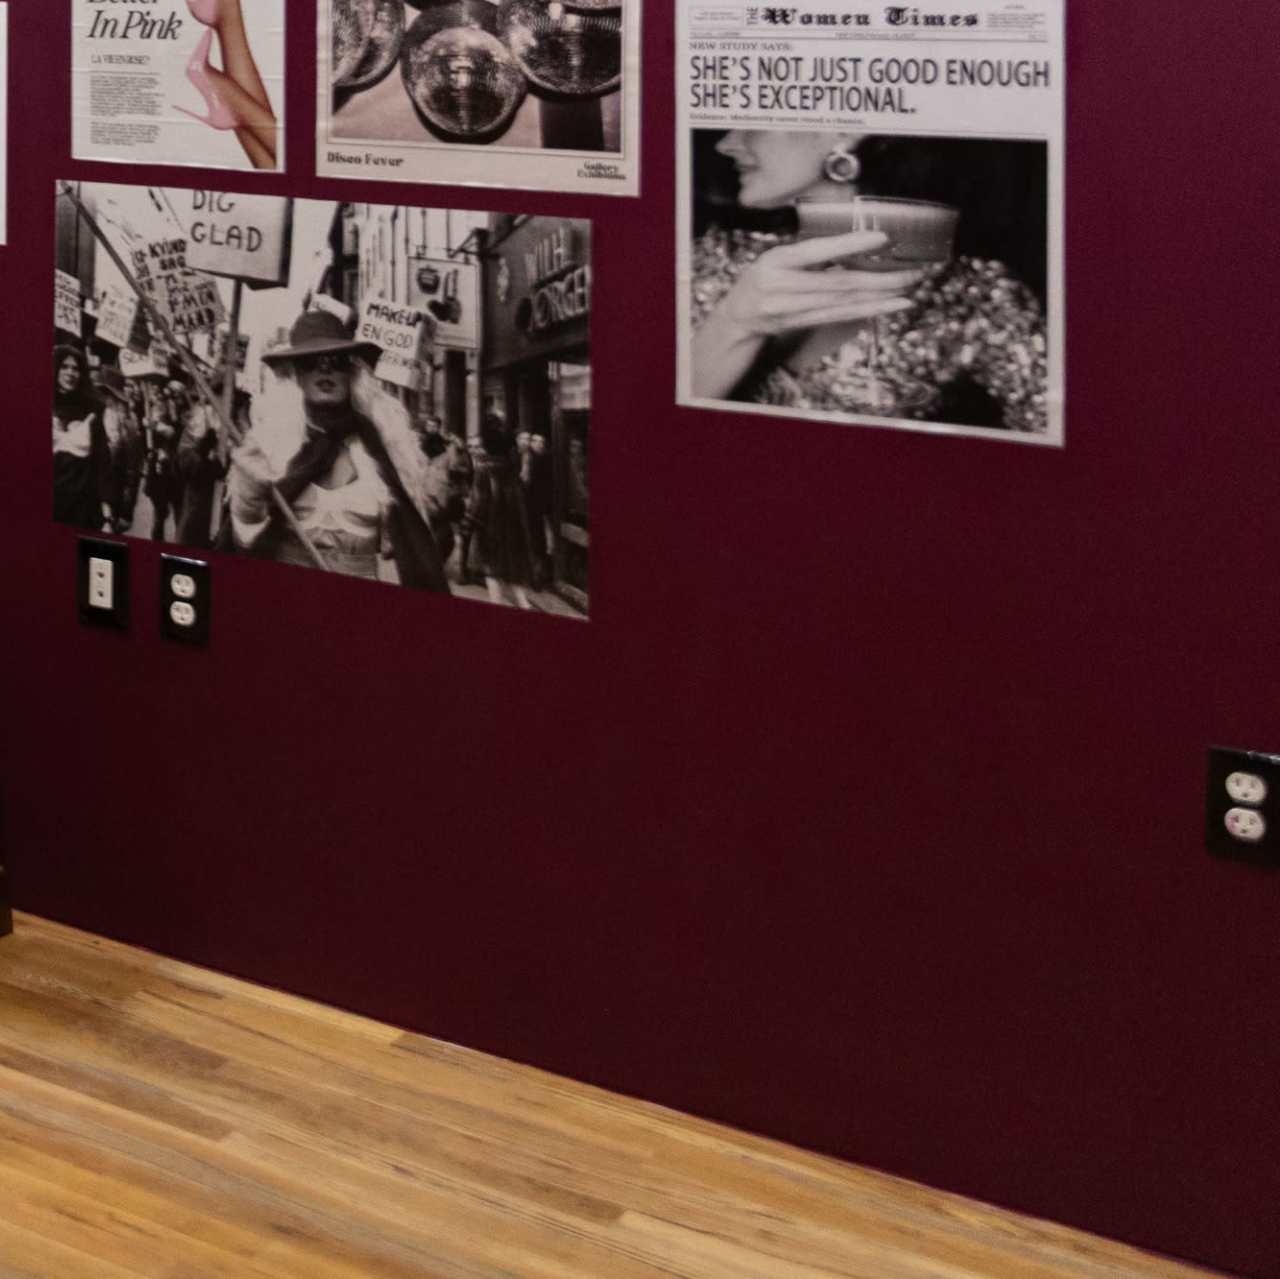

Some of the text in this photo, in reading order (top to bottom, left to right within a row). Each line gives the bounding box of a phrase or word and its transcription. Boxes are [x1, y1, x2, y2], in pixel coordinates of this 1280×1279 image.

[87, 10, 183, 40] In Pink
[762, 6, 871, 26] Women
[884, 5, 979, 26] Times
[690, 55, 1050, 87] SHE'S NOT JUST GOOD ENOUGH
[690, 83, 917, 114] SHE'S EXCEPTIONAL.
[327, 151, 404, 168] Disco Fever
[192, 190, 236, 213] DIG
[191, 222, 263, 252] GLAD
